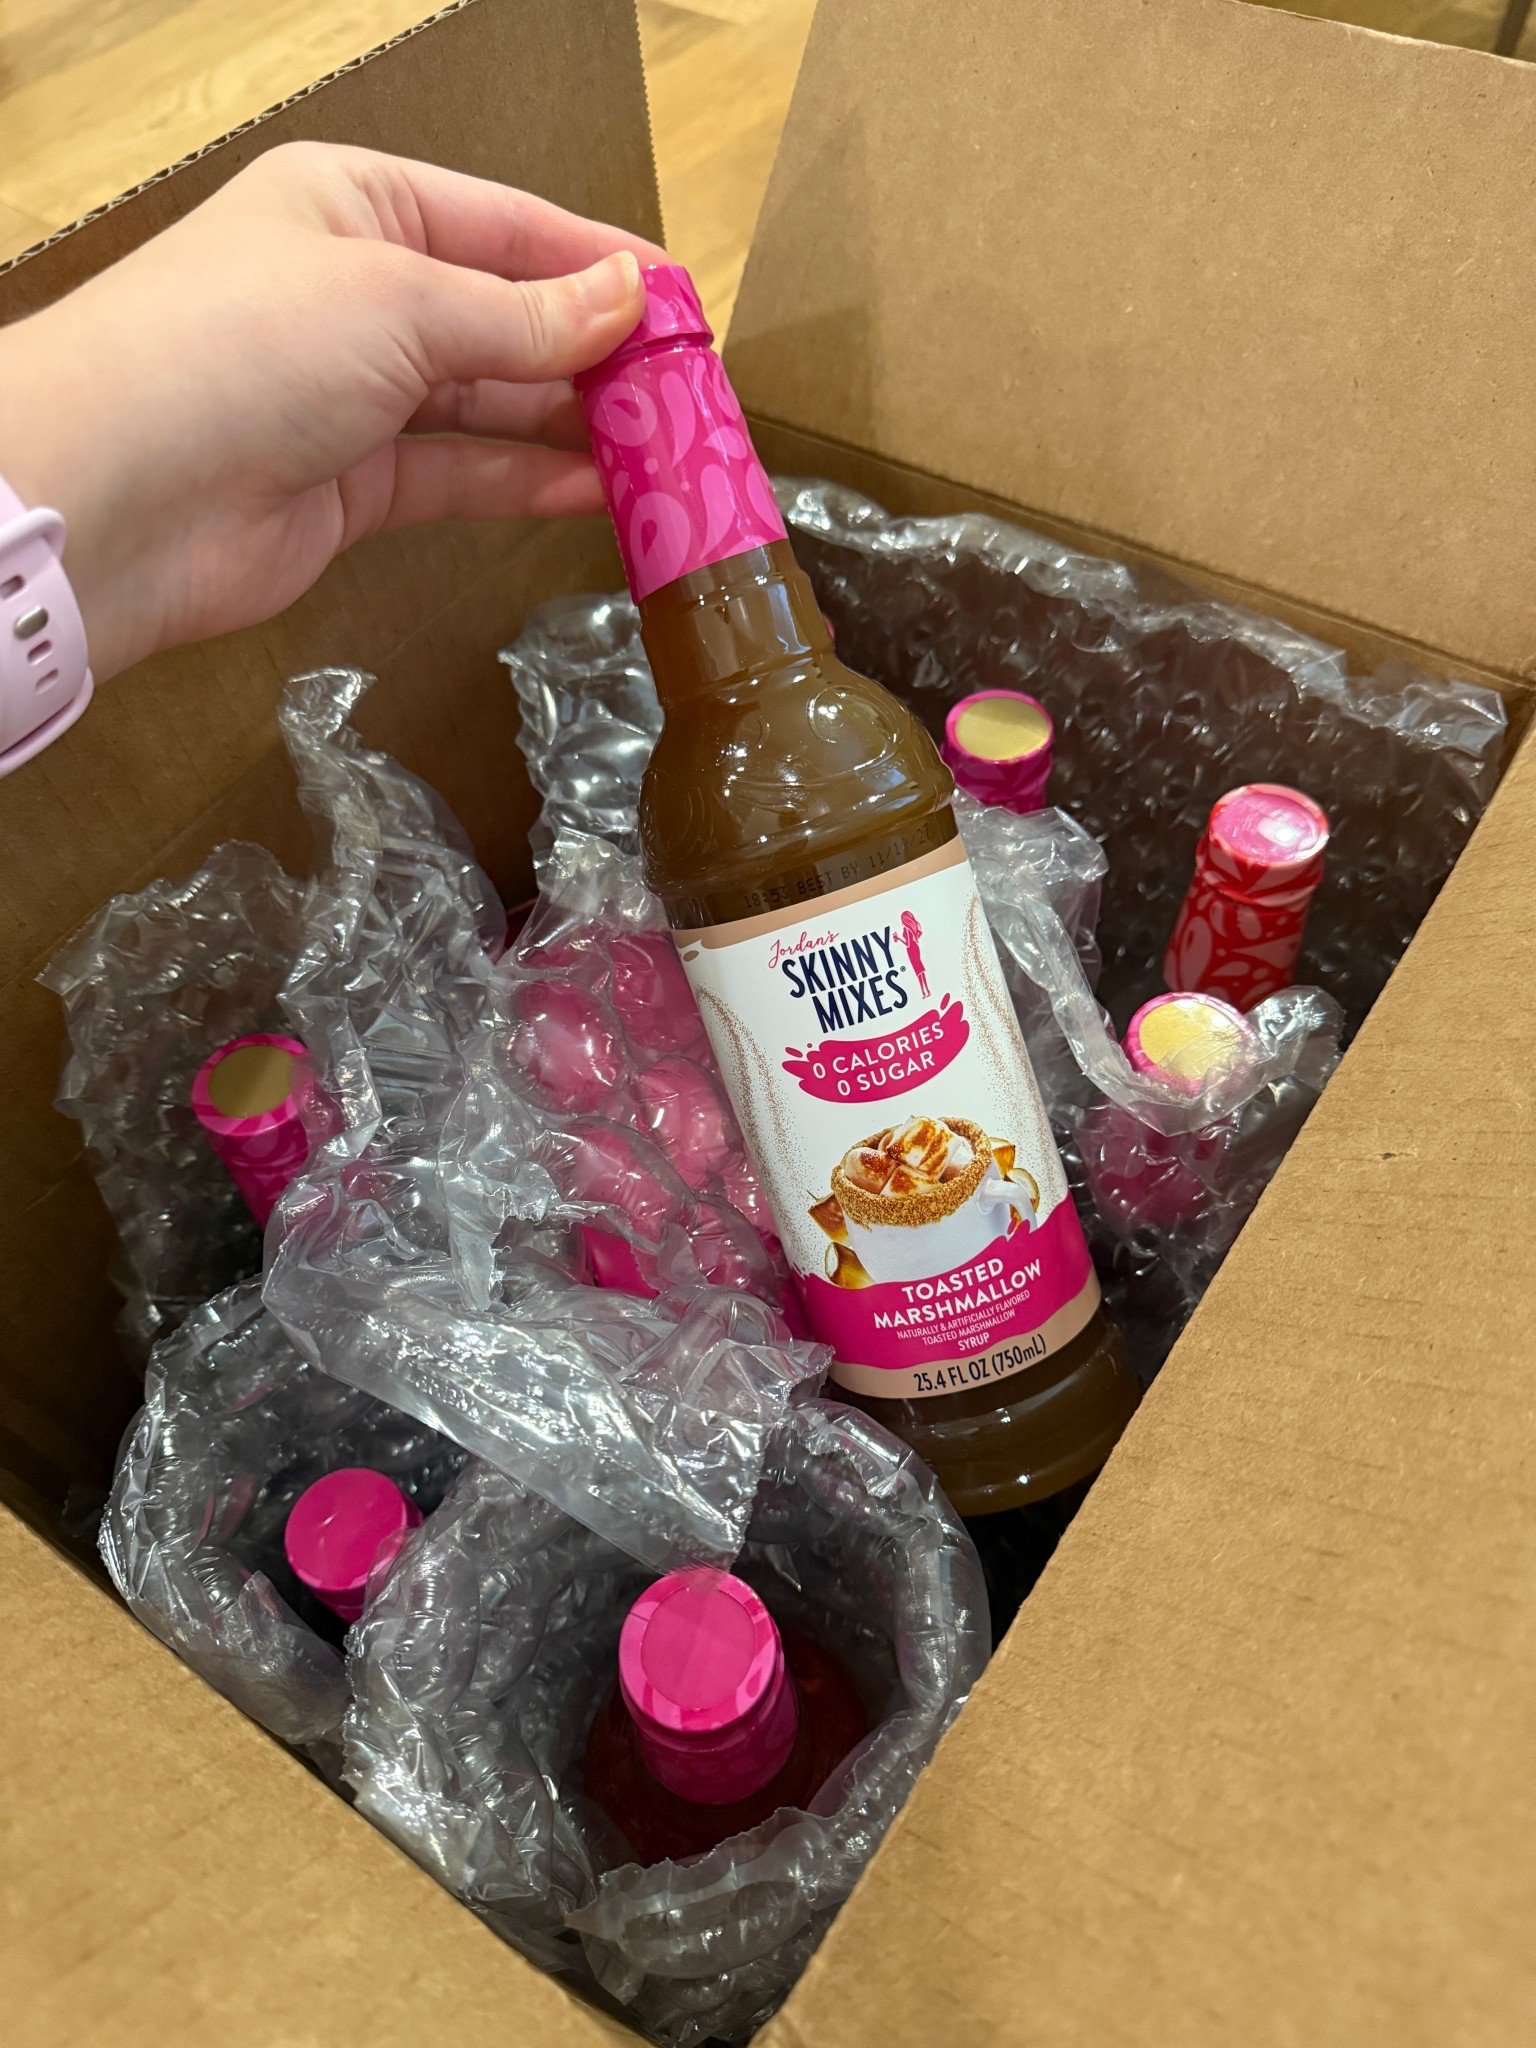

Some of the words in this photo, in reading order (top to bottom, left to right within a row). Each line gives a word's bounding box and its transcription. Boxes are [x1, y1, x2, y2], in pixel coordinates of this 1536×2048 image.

[797, 871, 833, 896] BEST
[840, 860, 858, 880] BY
[768, 931, 839, 969] Jordan's
[781, 926, 895, 999] SKINNY
[812, 1062, 827, 1079] 0
[832, 1022, 944, 1075] CALORIES
[837, 1079, 851, 1096] 0
[857, 1050, 935, 1091] SUGAR
[873, 1258, 1041, 1329] MARSHMALLOW
[901, 1258, 1004, 1303] TOASTED
[897, 1324, 939, 1340] NATURALLY
[940, 1323, 947, 1332] &
[947, 1305, 995, 1329] ARTIFICIALLY
[996, 1289, 1031, 1312] FLAVORED
[922, 1332, 957, 1346] TOASTED
[959, 1309, 1016, 1337] MARSHMALLOW
[914, 1369, 946, 1392] 25.4
[947, 1367, 968, 1386] FL
[968, 1358, 990, 1380] OZ
[992, 1333, 1046, 1376] (750mL)
[958, 1332, 990, 1351] SYRUP
